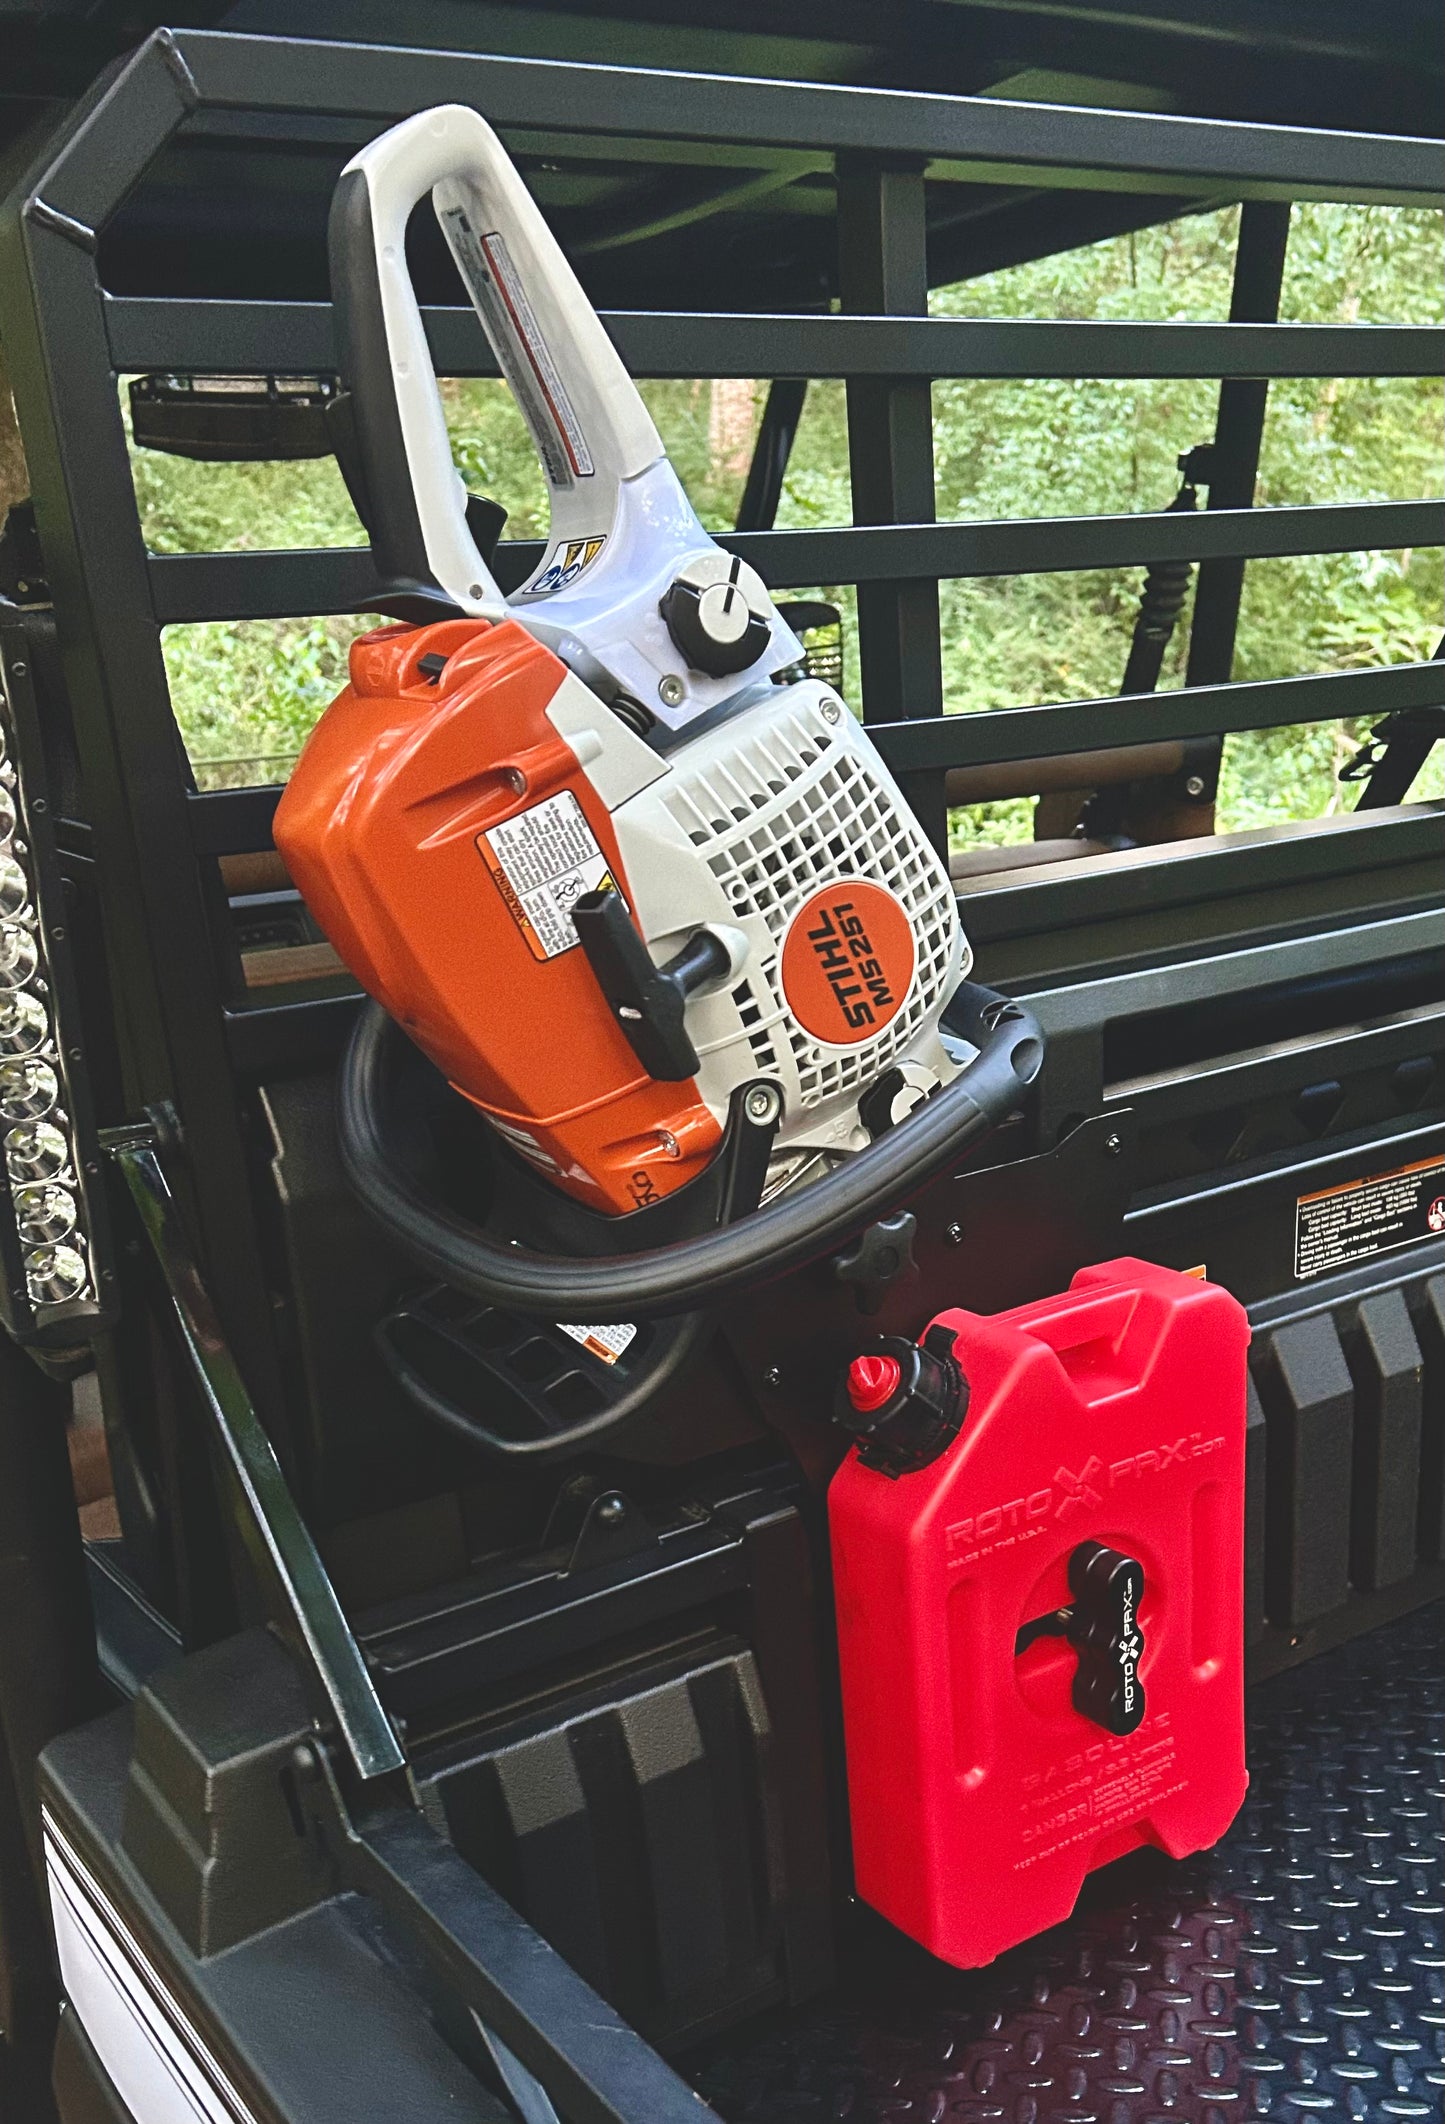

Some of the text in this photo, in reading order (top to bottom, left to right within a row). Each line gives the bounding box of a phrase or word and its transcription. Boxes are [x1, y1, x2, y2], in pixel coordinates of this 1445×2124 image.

[492, 867, 526, 920] WARNING
[507, 866, 522, 892] Operation
[807, 910, 875, 1028] STIHL
[833, 903, 894, 1007] MS 251
[944, 1487, 1053, 1552] ROTO
[1124, 1662, 1134, 1713] ROTO
[1022, 1802, 1088, 1843] DANGER
